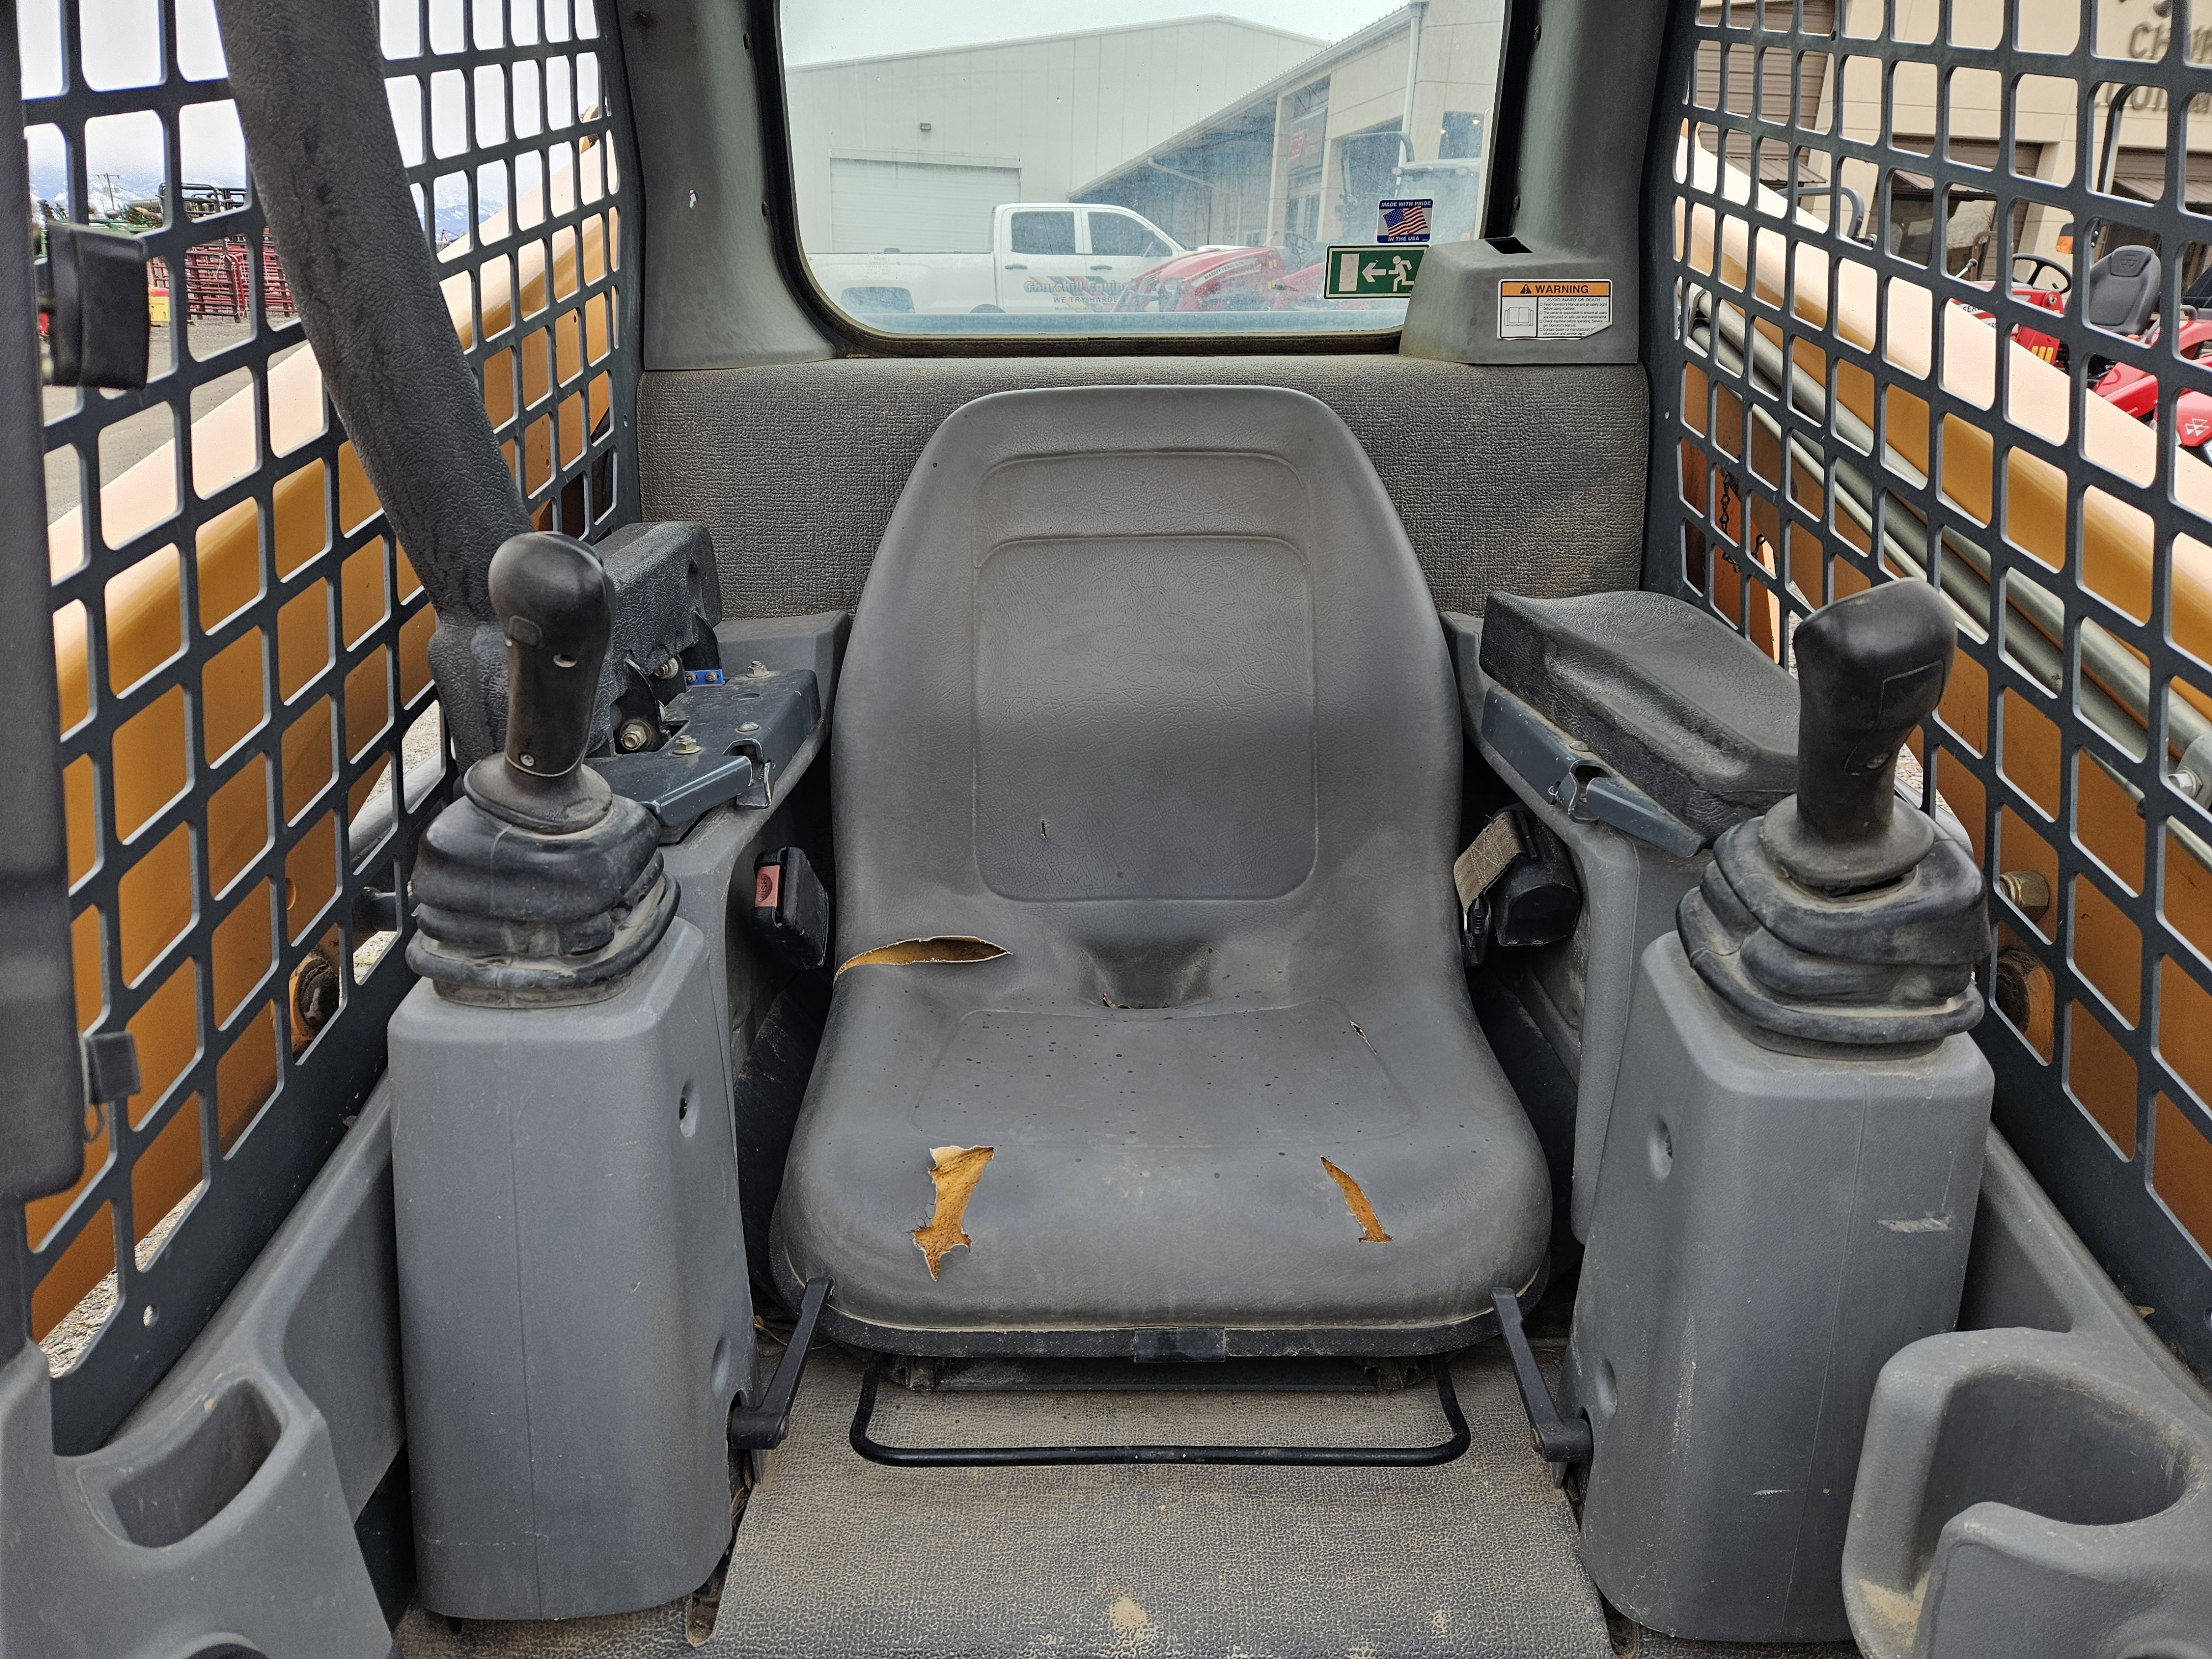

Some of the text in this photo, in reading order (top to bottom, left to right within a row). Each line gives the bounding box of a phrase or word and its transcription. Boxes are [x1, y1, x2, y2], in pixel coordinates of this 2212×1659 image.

[1204, 269, 1221, 279] MASSEY
[1024, 280, 1083, 293] Churchill
[1535, 285, 1589, 294] WARNING
